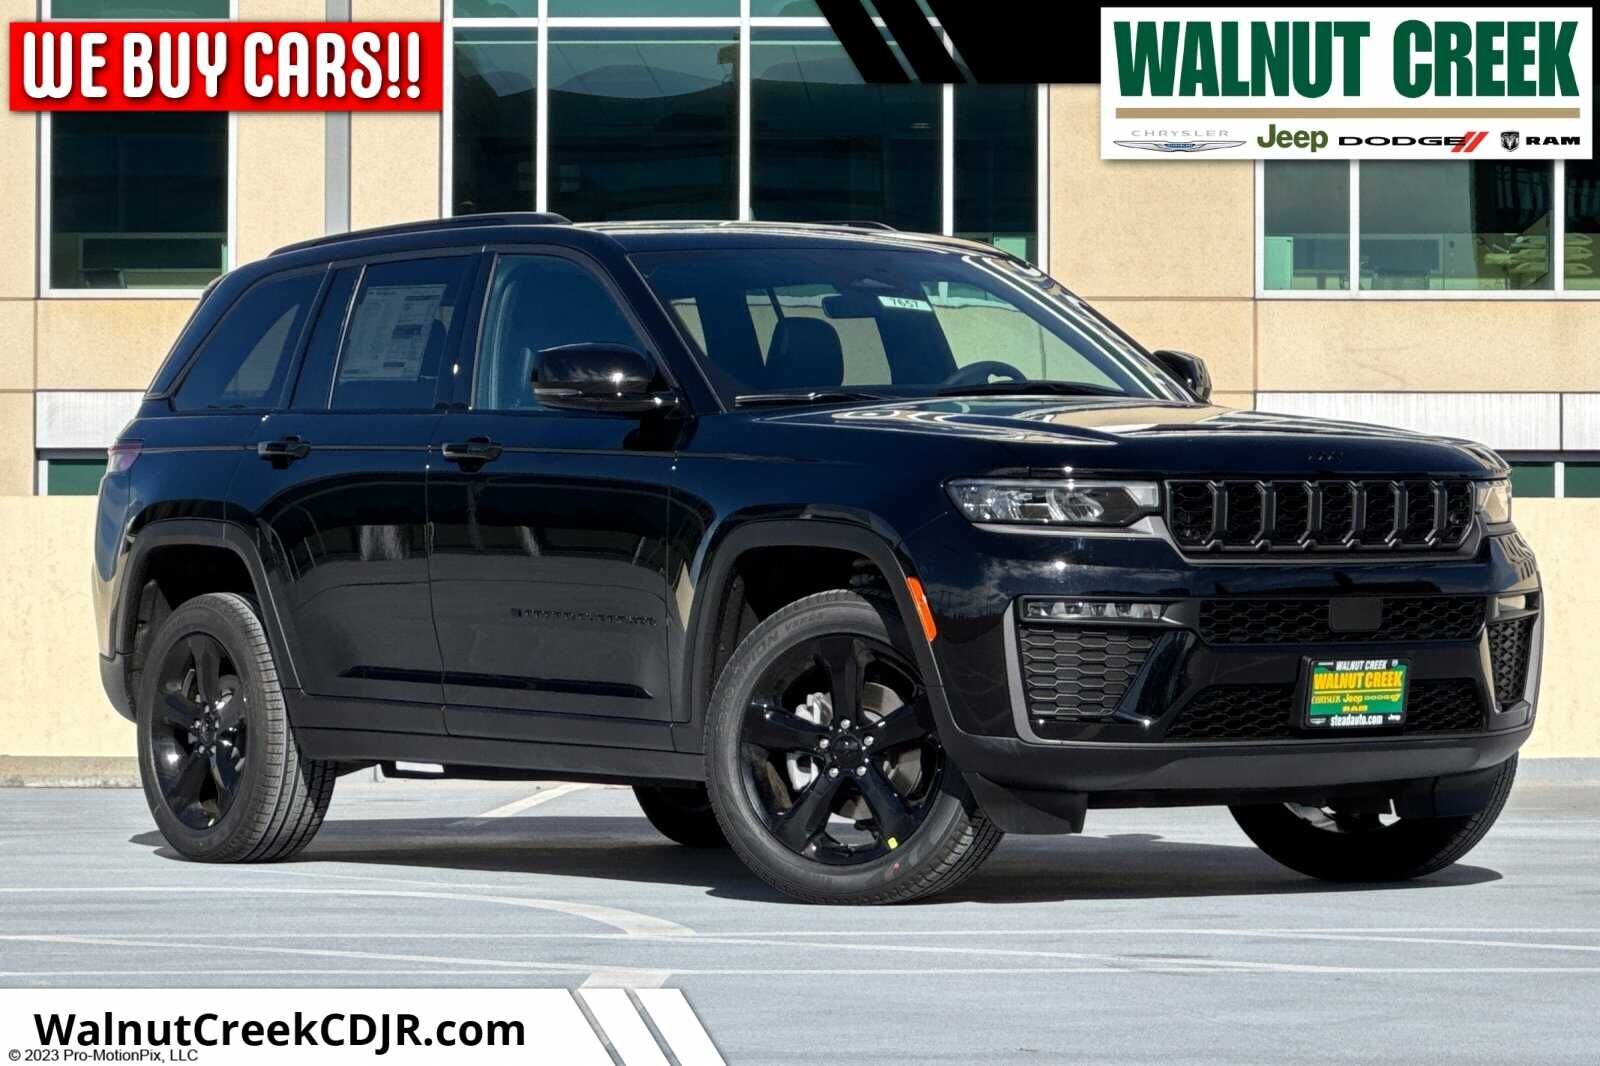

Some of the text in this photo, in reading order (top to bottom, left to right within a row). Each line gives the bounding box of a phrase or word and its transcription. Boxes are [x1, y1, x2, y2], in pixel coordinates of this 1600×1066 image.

[1335, 660, 1365, 671] WALNUT
[1365, 659, 1388, 670] CREEK
[1313, 670, 1403, 690] WALNUT CREEK
[1330, 714, 1383, 727] steadauto.com
